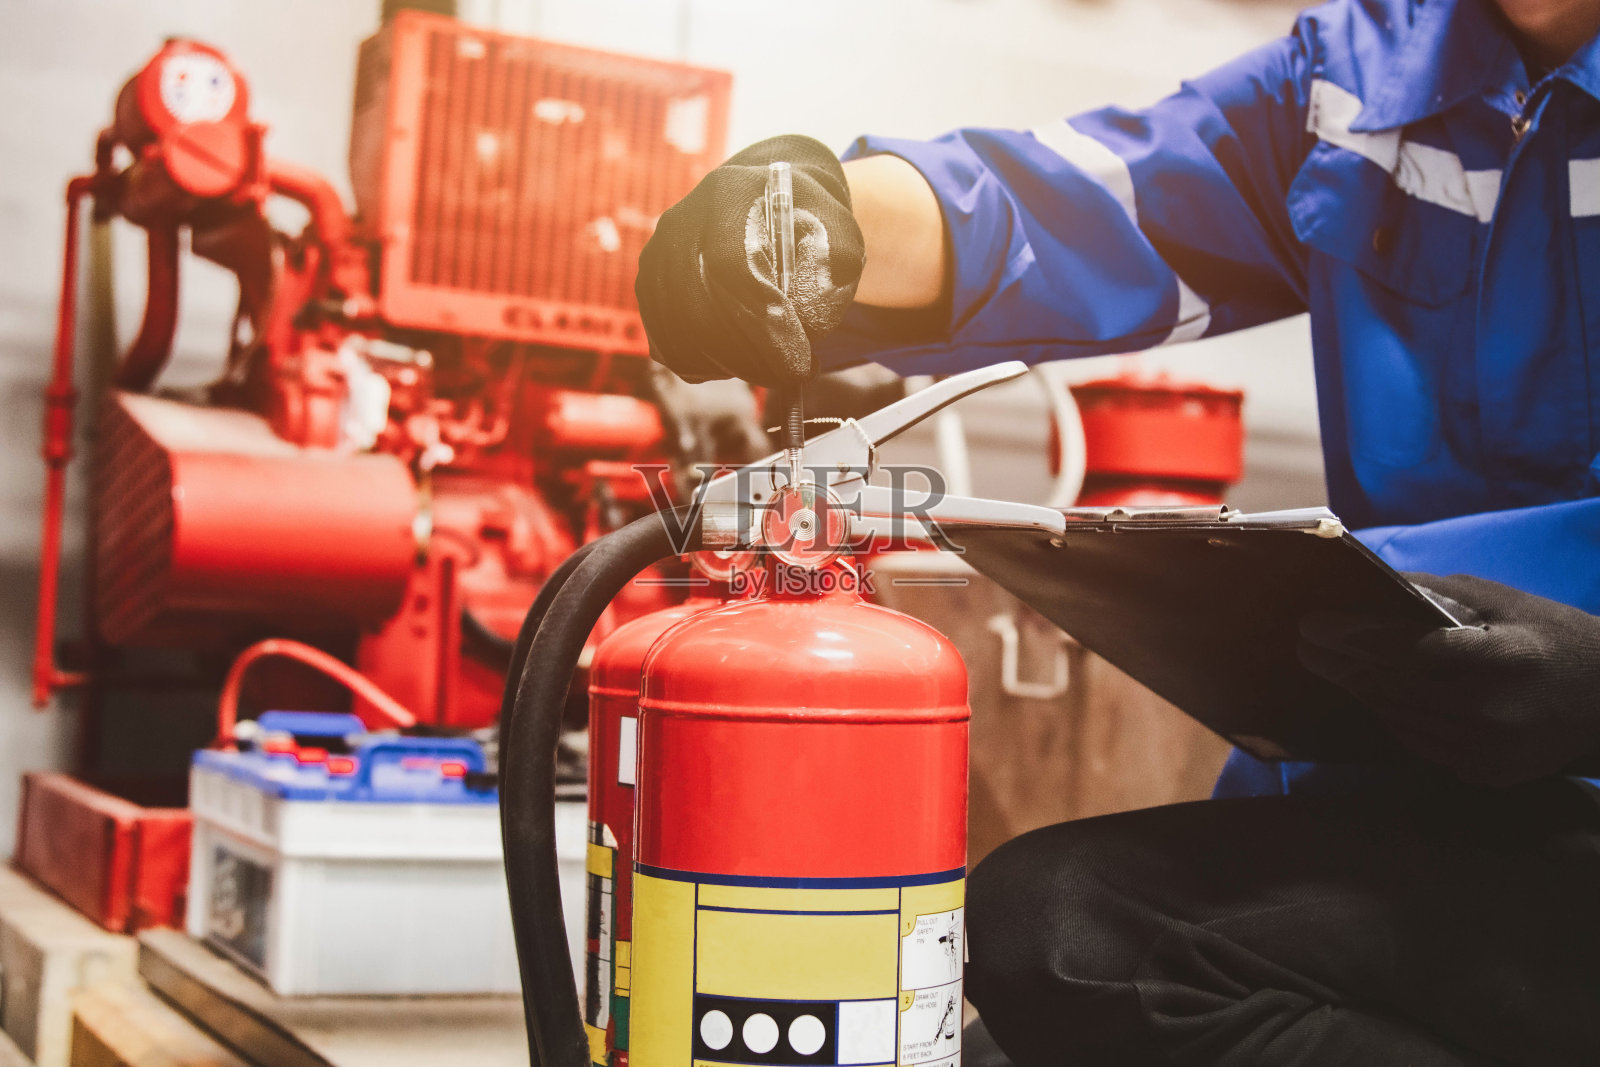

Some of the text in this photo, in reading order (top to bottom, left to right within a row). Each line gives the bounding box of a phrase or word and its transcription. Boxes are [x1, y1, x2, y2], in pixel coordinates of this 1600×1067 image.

[930, 917, 939, 925] OUT
[917, 927, 934, 935] SAFETY
[905, 996, 910, 1004] 2
[903, 1042, 919, 1051] START
[907, 1052, 919, 1060] FEET
[920, 1050, 932, 1058] BACK
